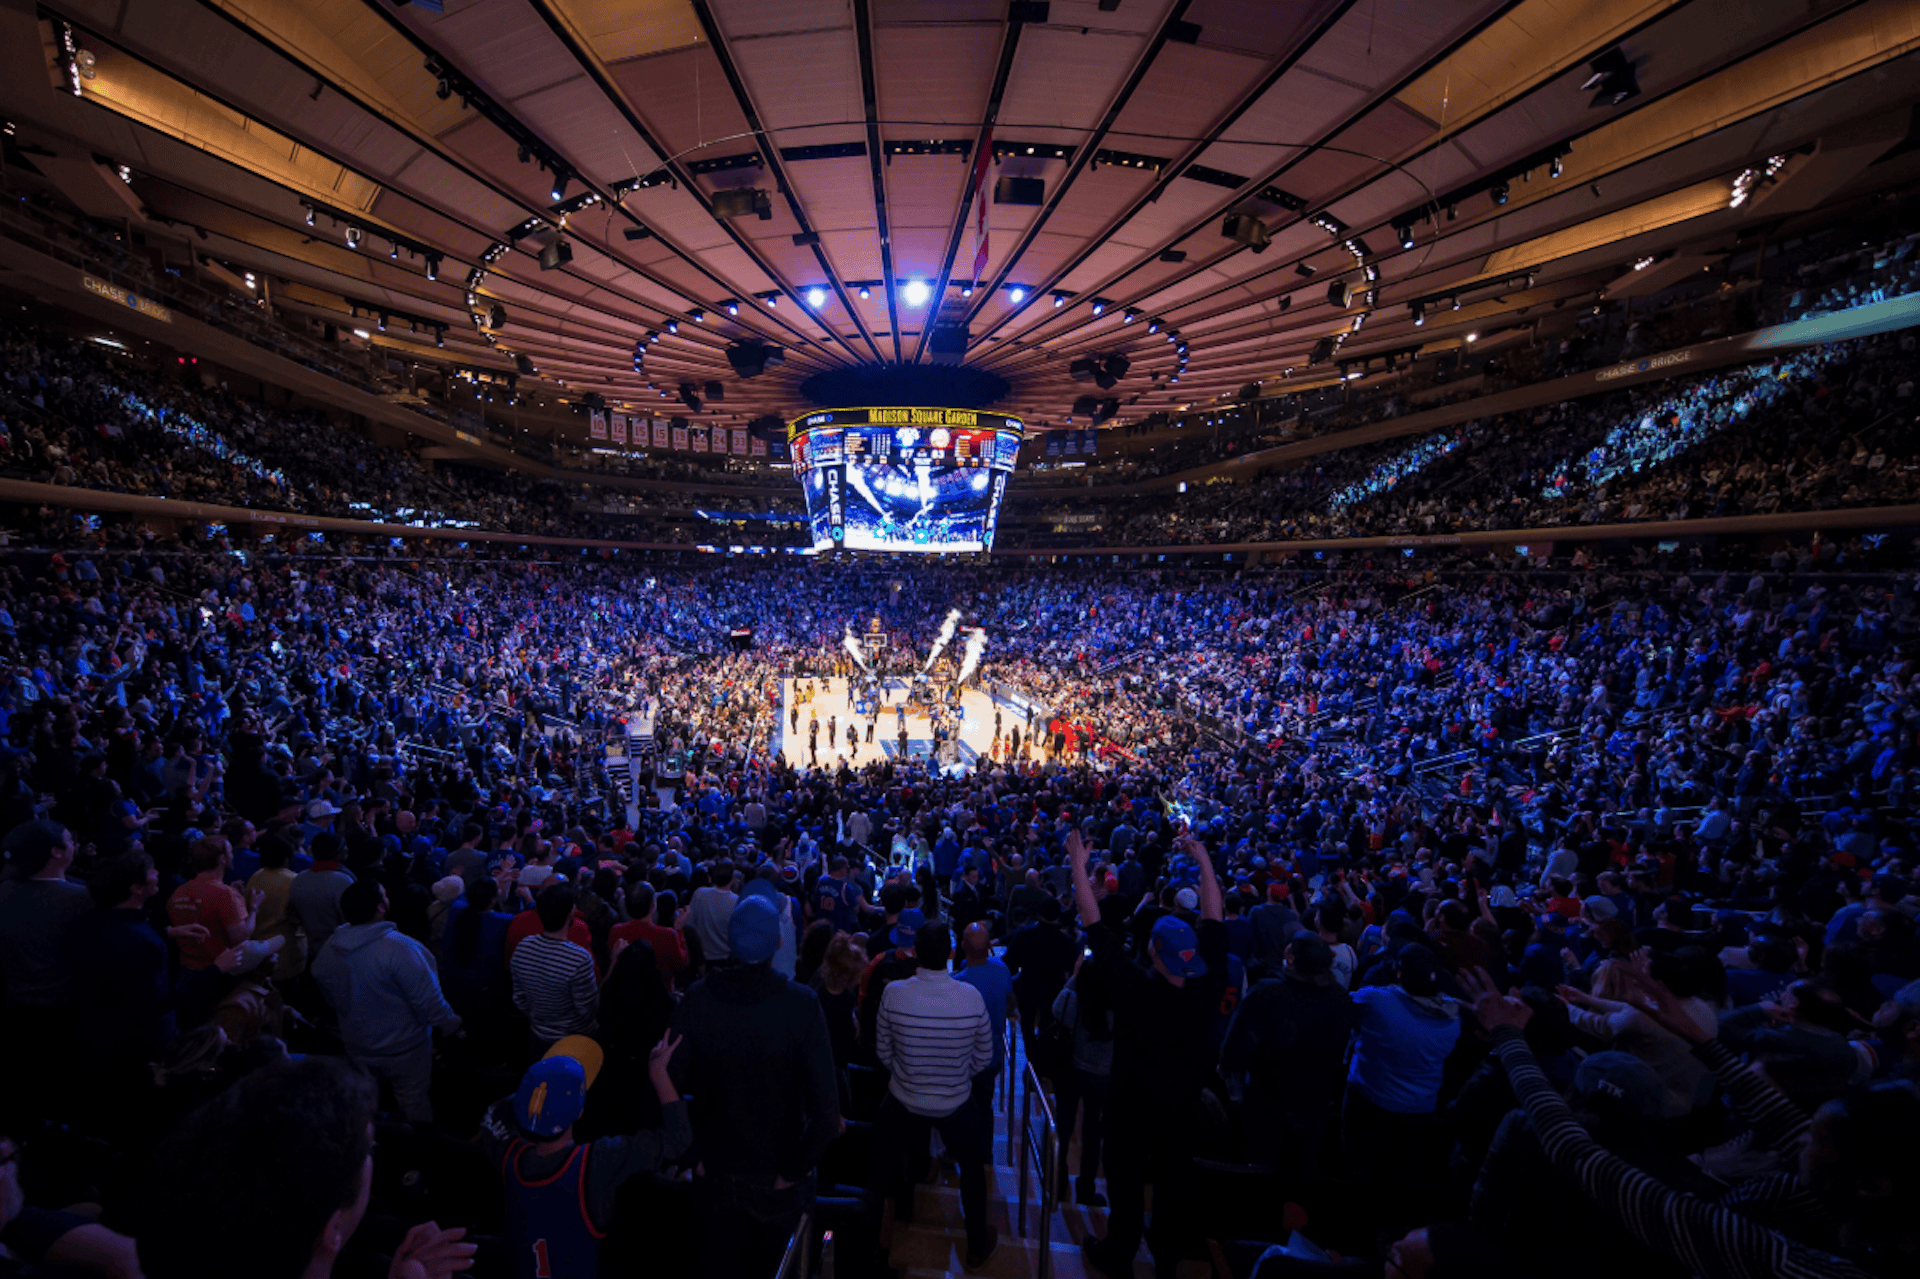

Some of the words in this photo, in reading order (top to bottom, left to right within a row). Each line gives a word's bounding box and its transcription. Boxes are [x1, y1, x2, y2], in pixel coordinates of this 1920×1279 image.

[84, 277, 125, 303] CHASE
[1595, 363, 1637, 380] CHASE
[1651, 351, 1690, 369] BRIDGE
[869, 409, 909, 423] MADISON
[911, 407, 943, 424] SQUARE
[944, 409, 977, 425] GARDEN
[593, 419, 604, 430] 10
[613, 422, 623, 433] 12
[635, 426, 646, 437] 15
[655, 429, 666, 439] 15
[713, 434, 724, 445] 24
[828, 469, 841, 525] CHASE
[821, 896, 836, 912] 10
[531, 1238, 551, 1279] 1
